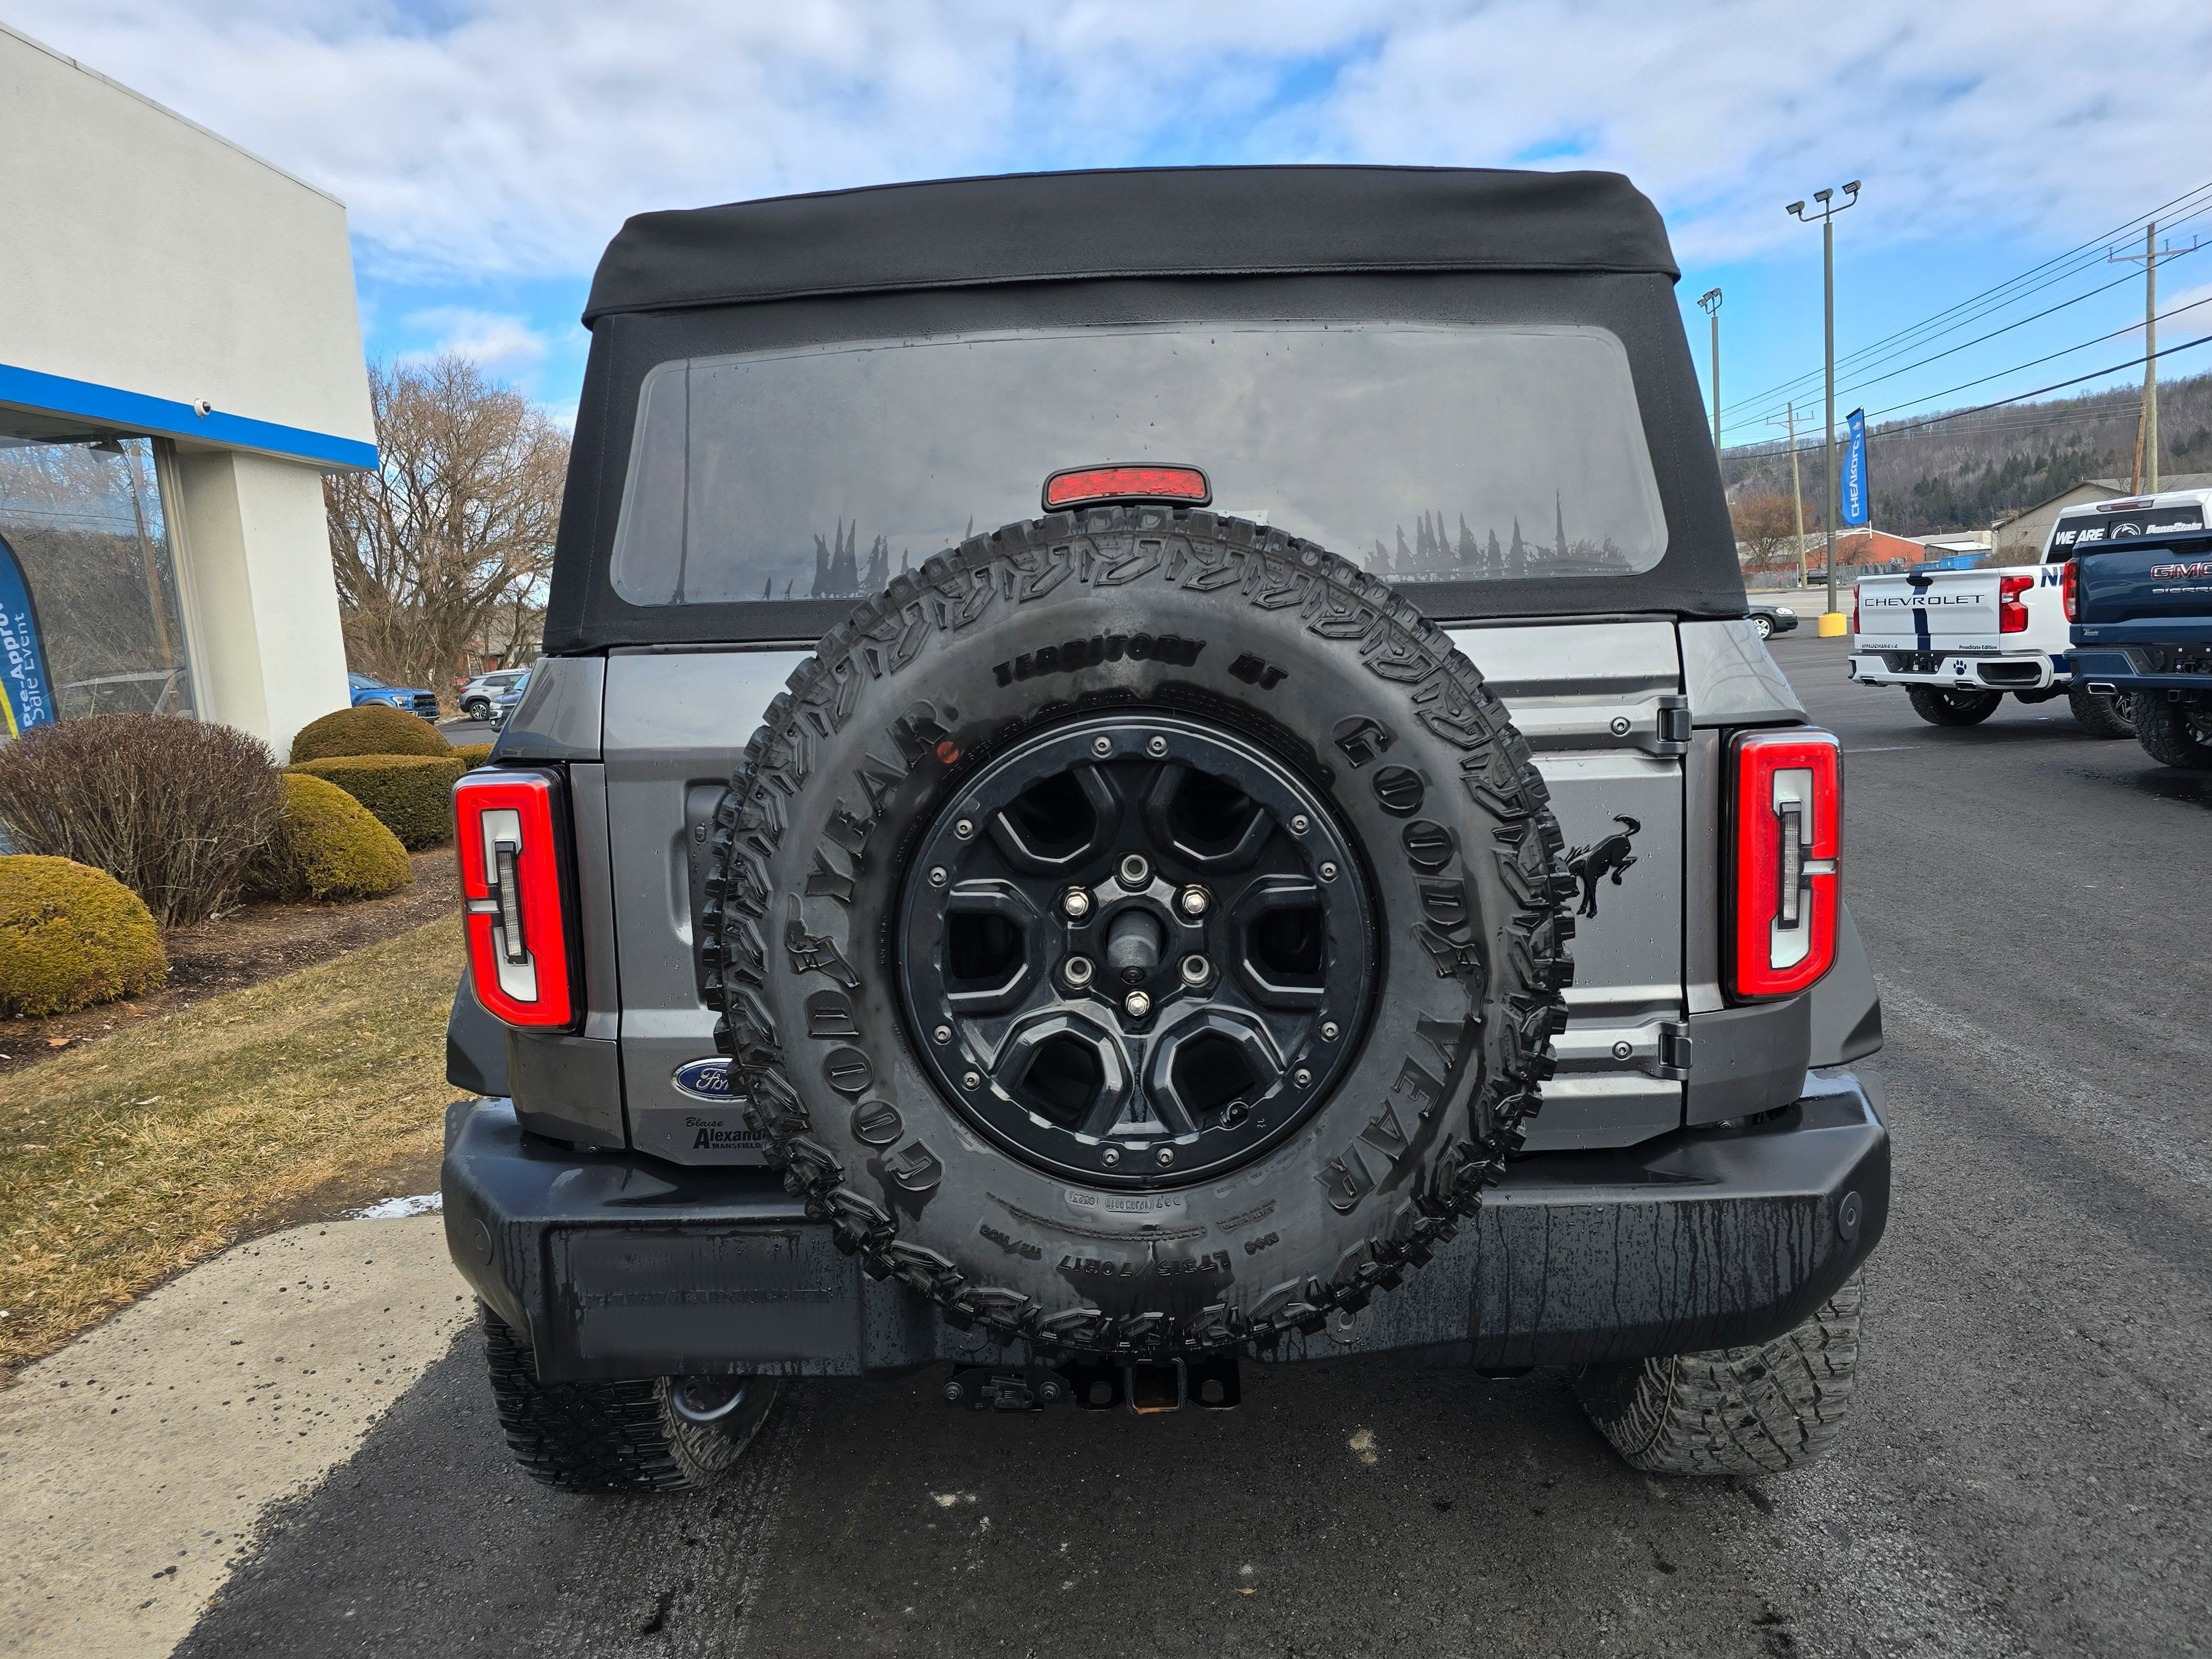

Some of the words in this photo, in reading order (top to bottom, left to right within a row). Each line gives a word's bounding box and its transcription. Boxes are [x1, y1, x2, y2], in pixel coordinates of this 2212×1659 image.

[2056, 530, 2077, 545] WE
[2075, 528, 2105, 543] ARE
[1865, 594, 1985, 607] CHEVROLET
[14, 613, 35, 671] Event
[992, 633, 1207, 687] TERRITORY
[27, 678, 45, 721] Sale
[685, 1117, 724, 1127] Blaise
